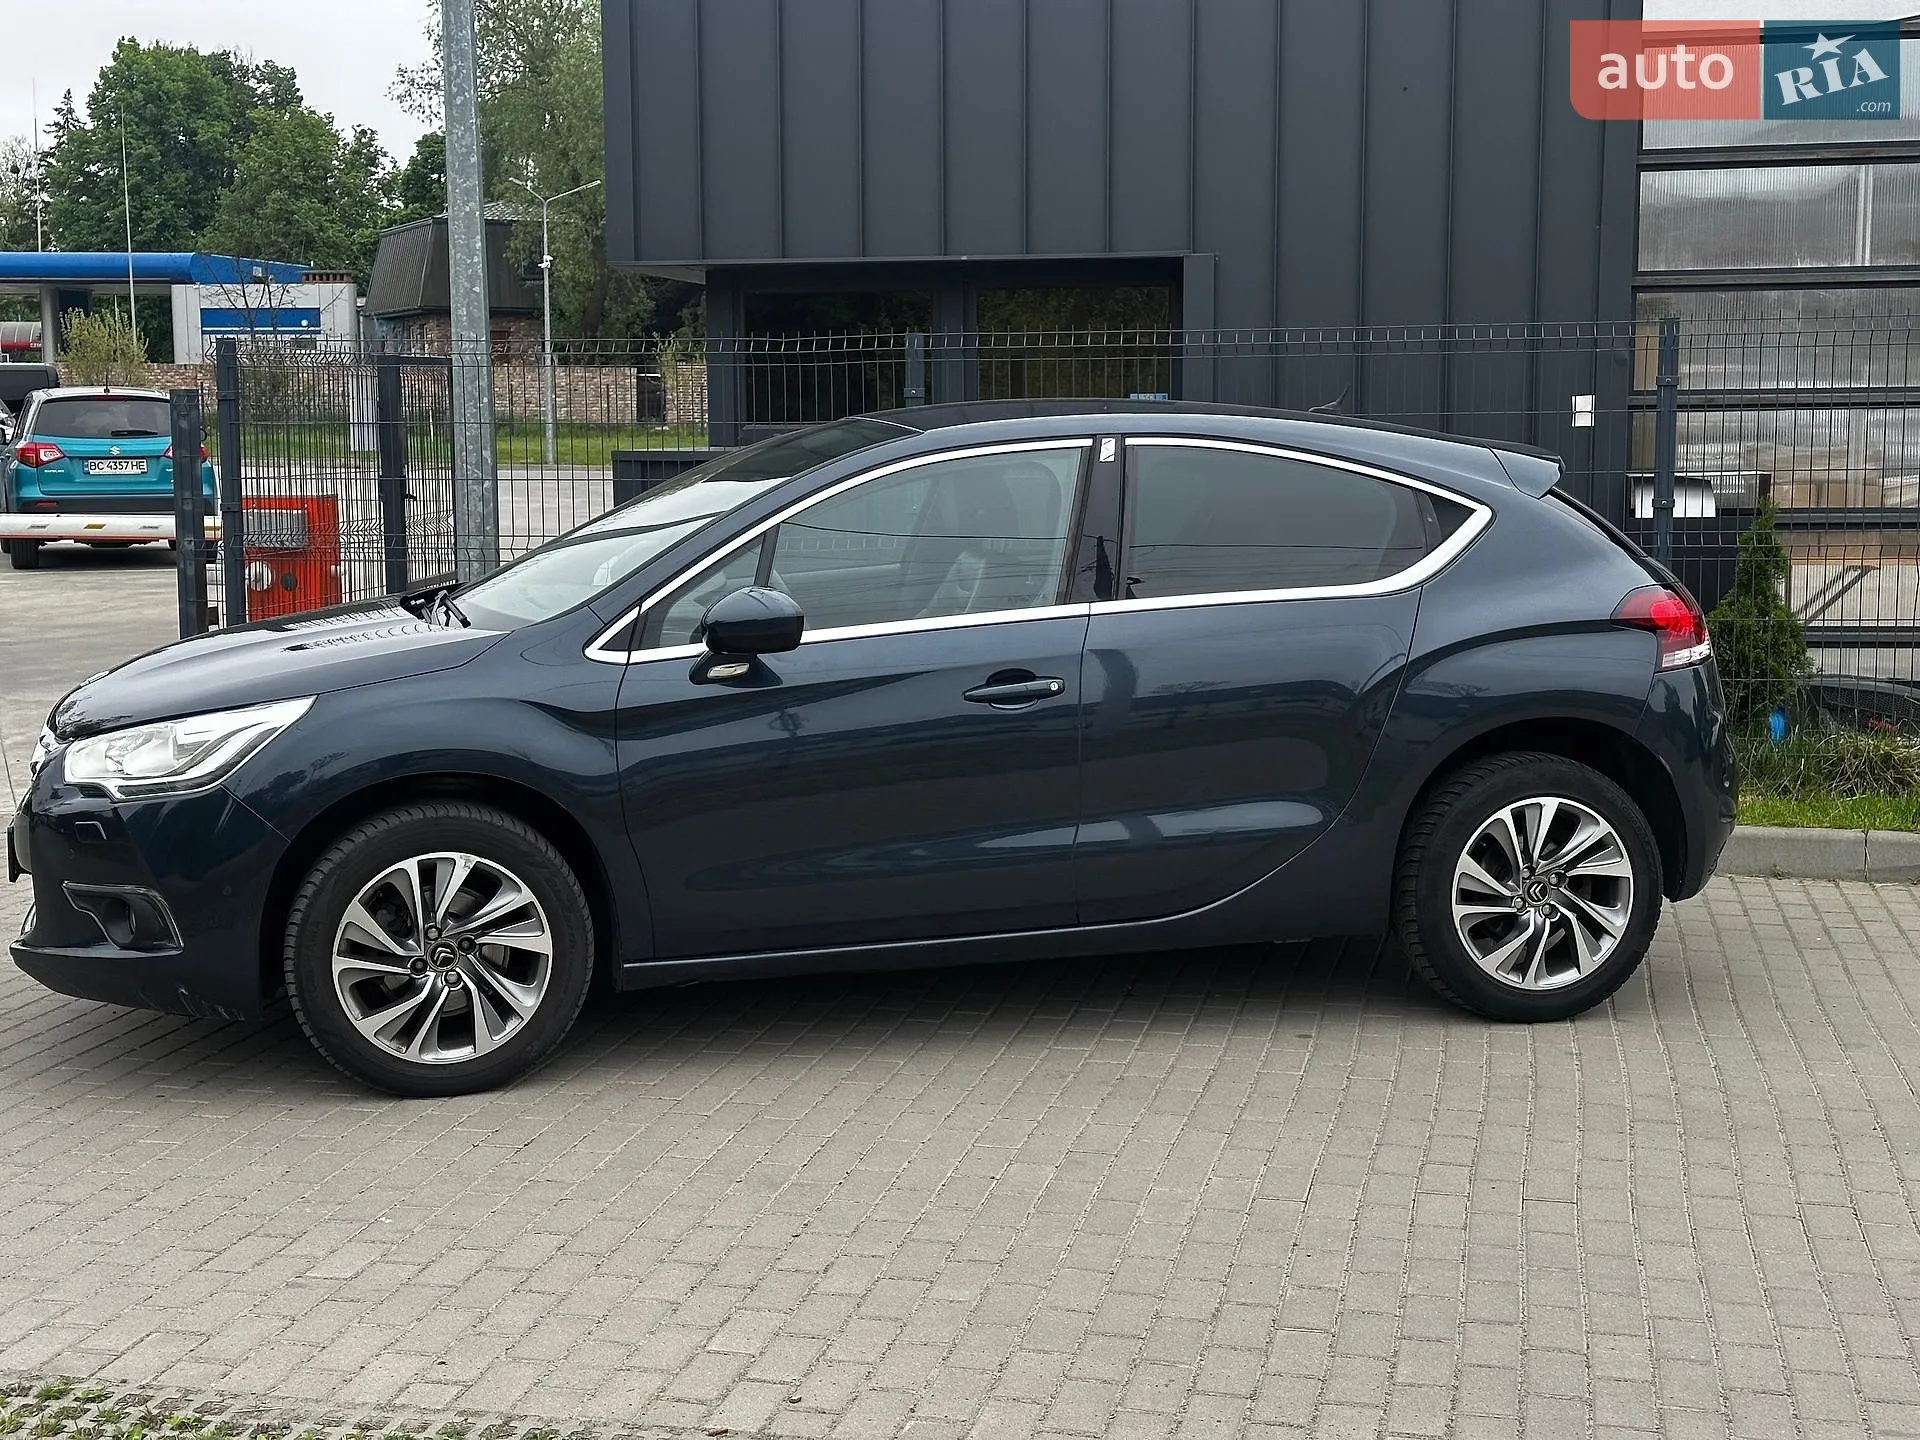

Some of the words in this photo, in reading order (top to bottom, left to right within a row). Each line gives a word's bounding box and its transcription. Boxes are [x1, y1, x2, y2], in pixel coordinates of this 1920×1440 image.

[89, 461, 104, 471] BC
[106, 461, 129, 471] 4357
[131, 460, 146, 471] HE
